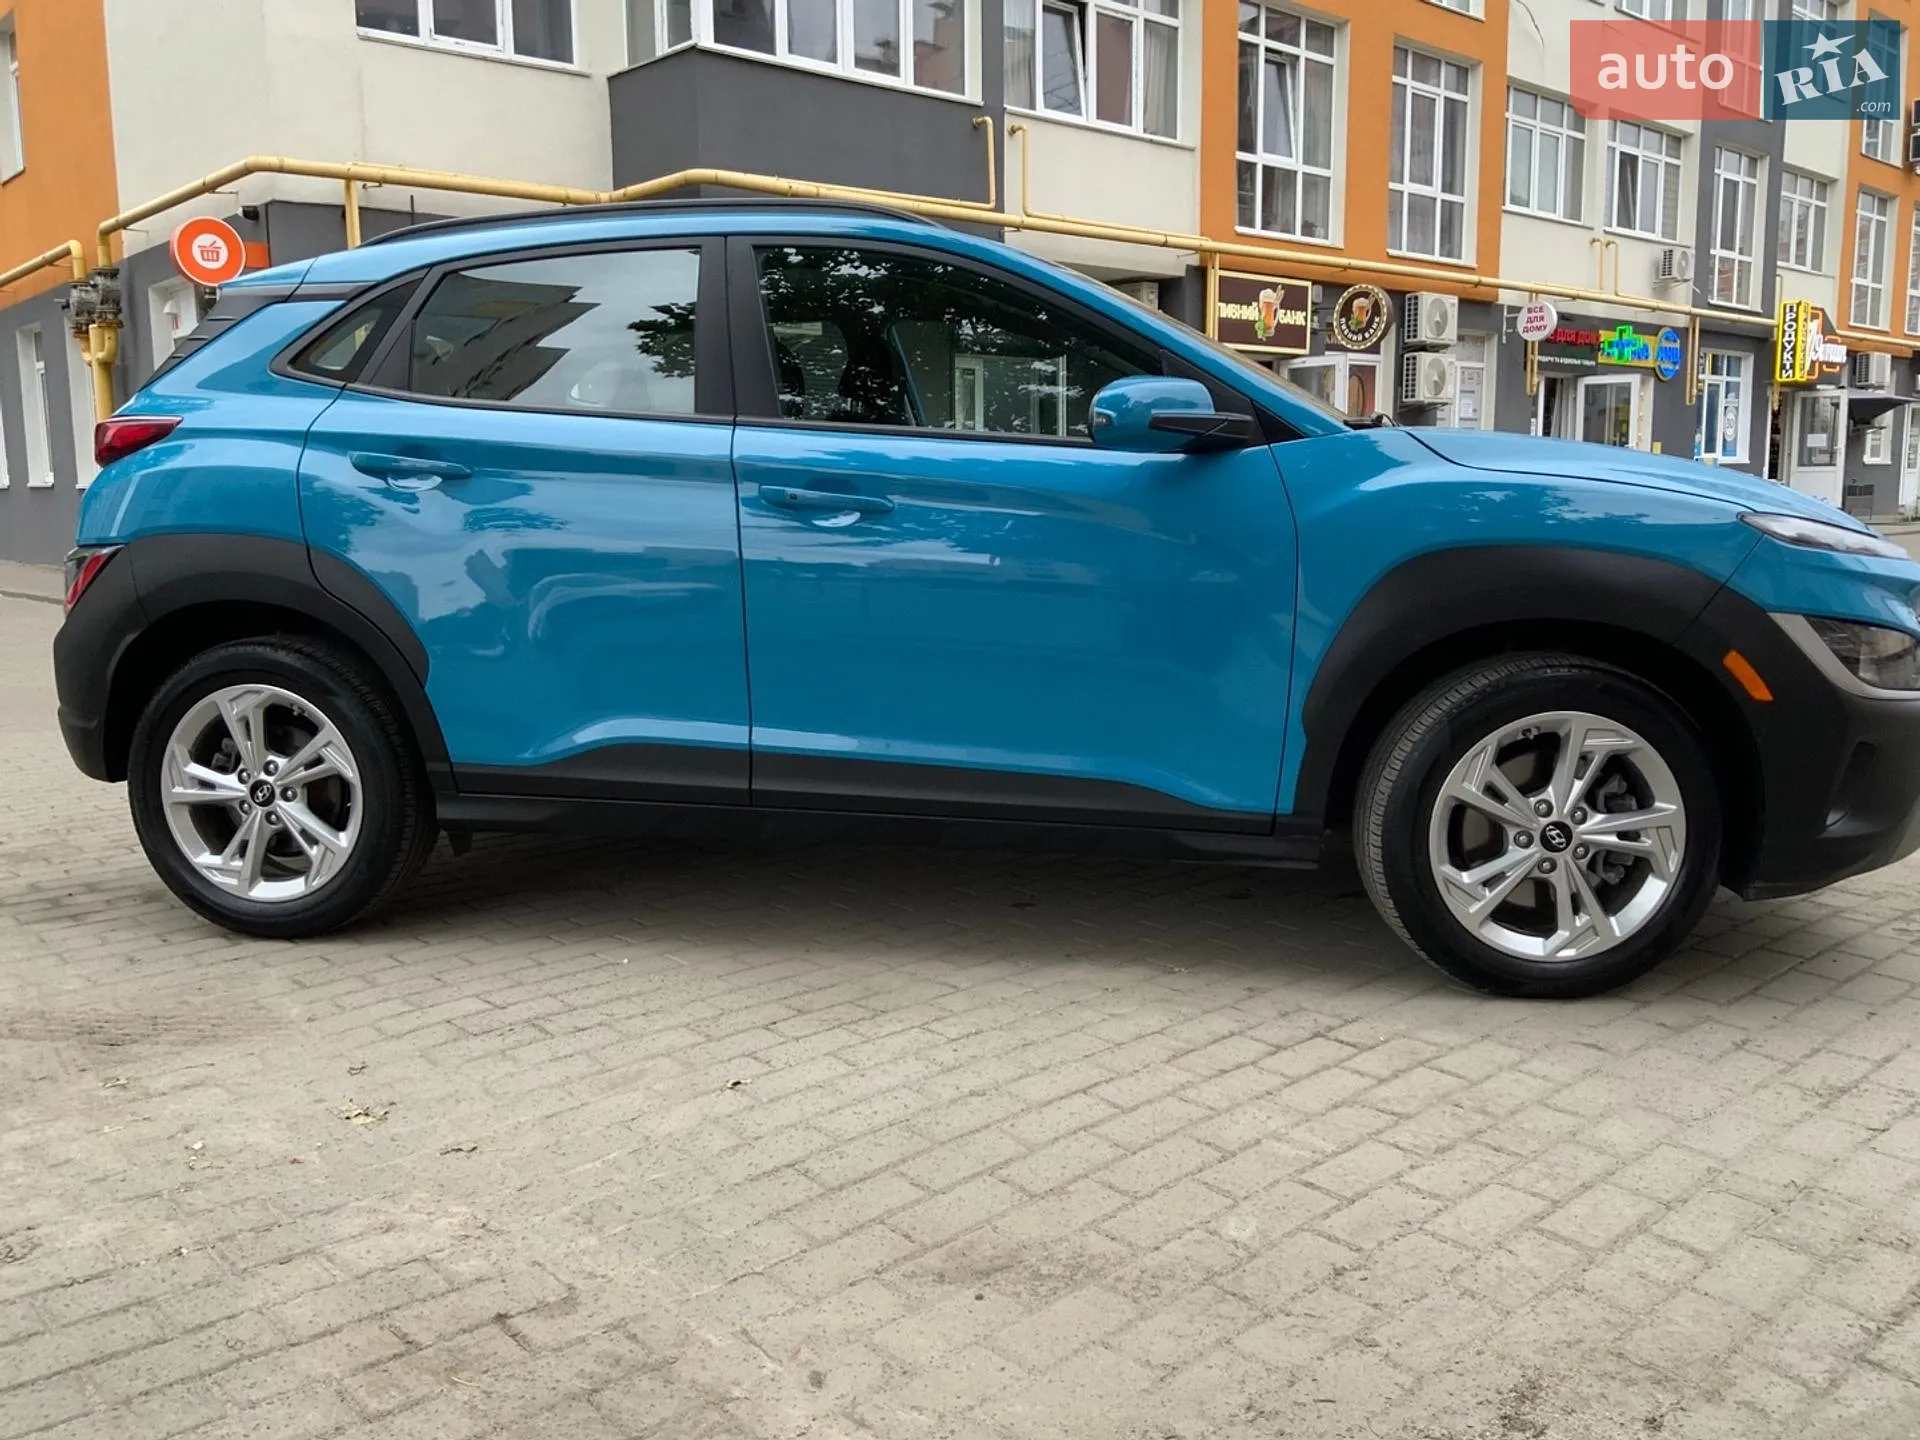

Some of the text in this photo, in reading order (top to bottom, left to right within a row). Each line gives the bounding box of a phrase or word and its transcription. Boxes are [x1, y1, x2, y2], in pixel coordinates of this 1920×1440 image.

[1218, 302, 1306, 326] ПИВНИЙ БАНК
[1526, 305, 1545, 314] ВСЕ
[1364, 316, 1380, 339] БАНК
[1526, 315, 1545, 324] ДЛЯ
[1522, 324, 1548, 335] ДОМУ
[1782, 303, 1797, 379] ПРОДУКТИ
